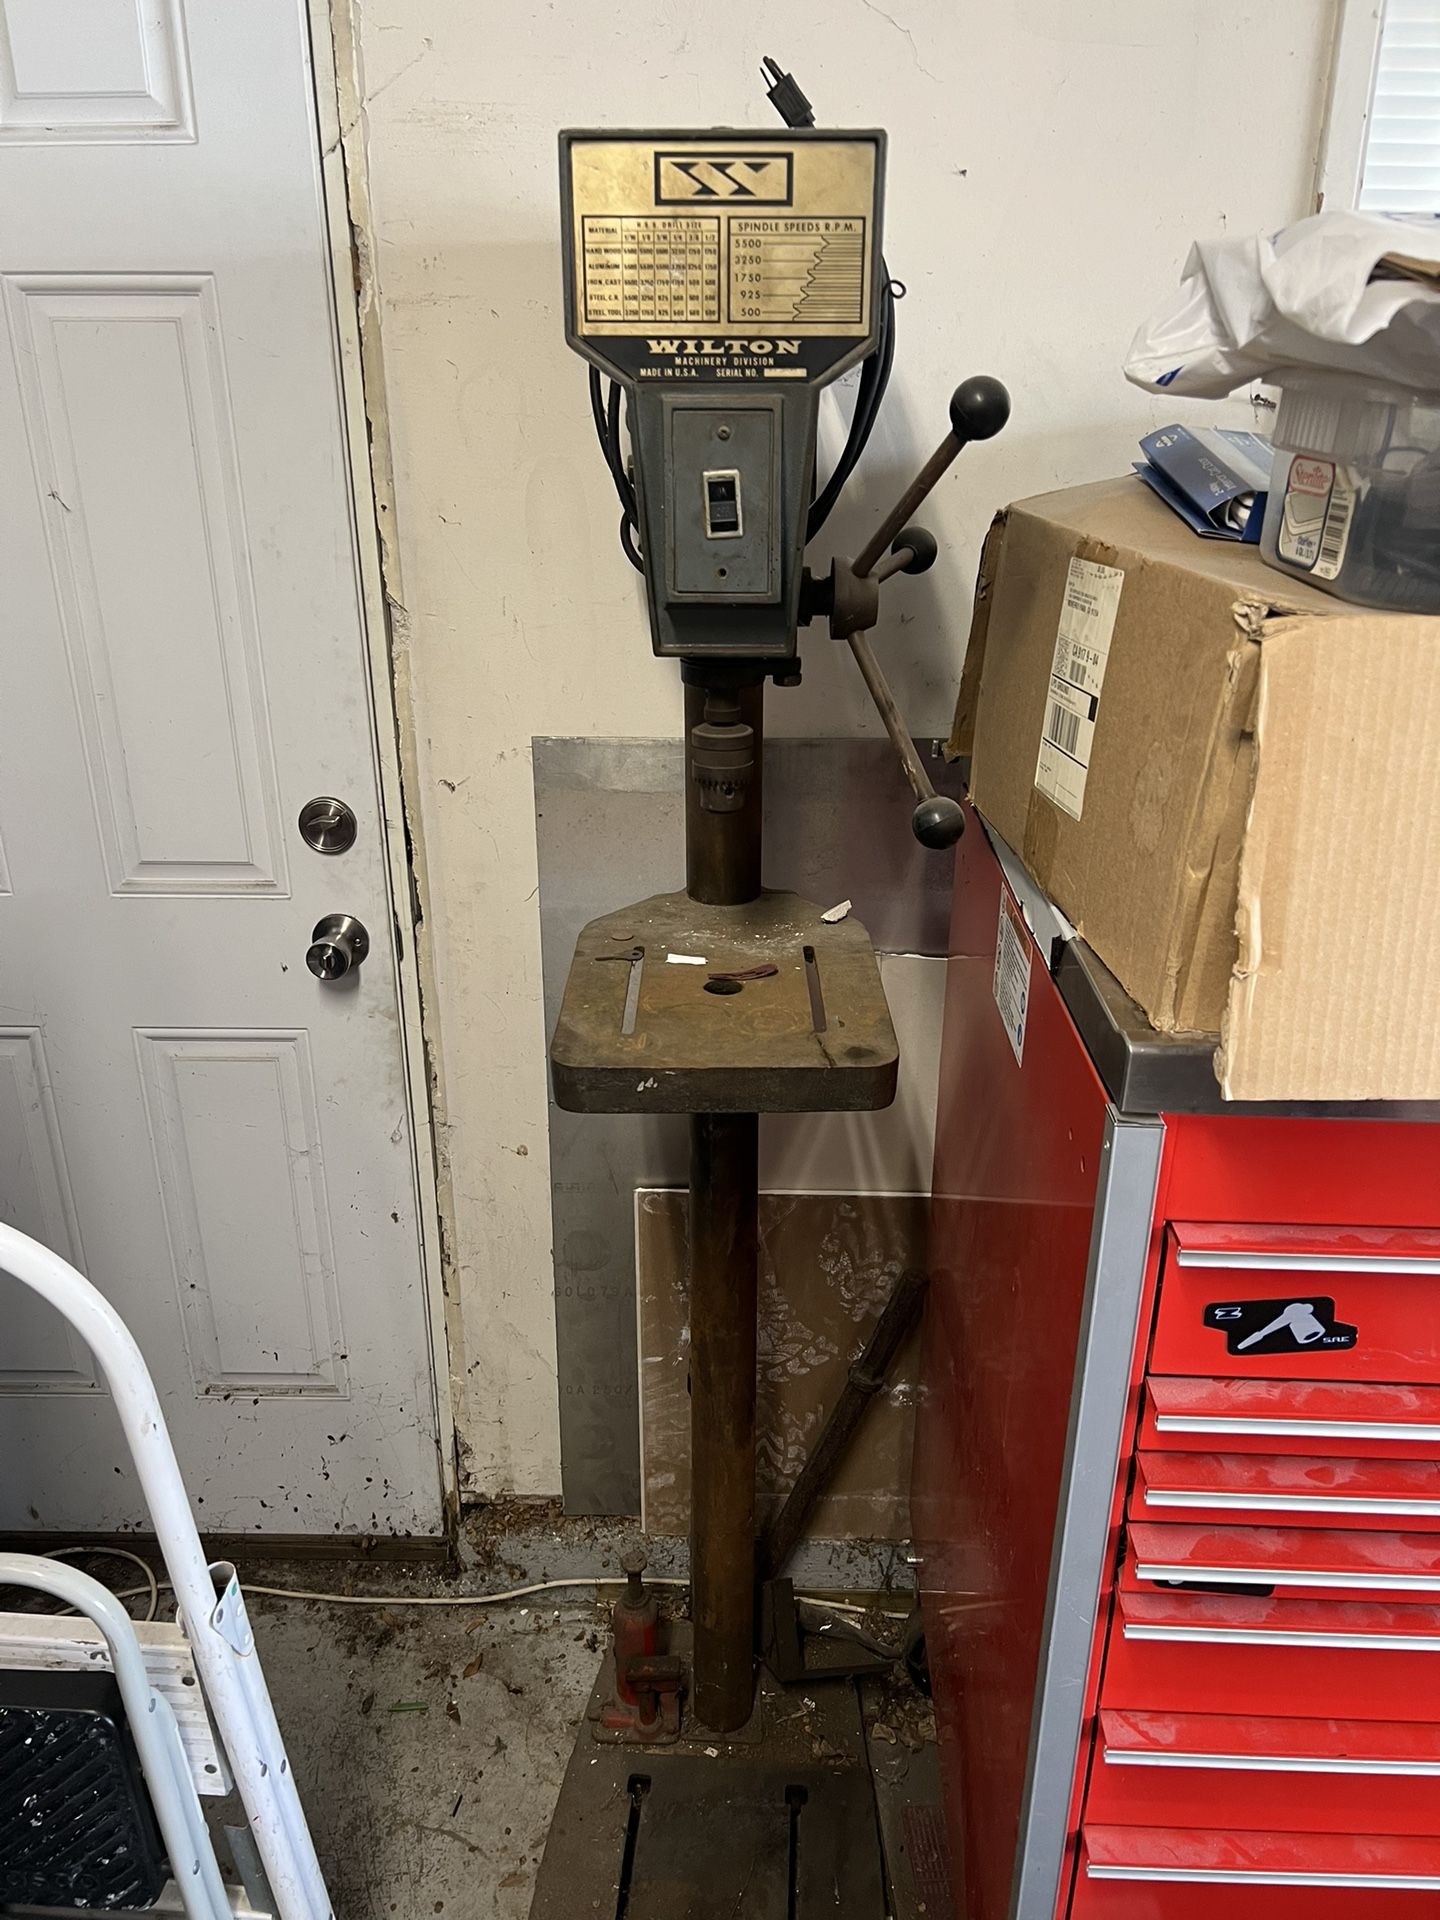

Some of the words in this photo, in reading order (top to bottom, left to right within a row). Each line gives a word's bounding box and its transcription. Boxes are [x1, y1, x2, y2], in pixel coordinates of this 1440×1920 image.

[738, 222, 779, 232] SPINDLE
[784, 222, 820, 232] SPEEDS
[735, 239, 762, 248] 5500
[735, 256, 762, 264] 3250
[735, 273, 761, 282] 1750
[740, 290, 760, 299] 925
[741, 308, 760, 317] 500
[646, 340, 802, 354] WILTON
[674, 357, 728, 366] MACHINERY
[734, 357, 774, 366] DIVISION
[640, 368, 662, 377] MADE
[664, 368, 672, 376] IN
[675, 368, 699, 377] U.S.A.
[716, 368, 743, 377] SERIAL
[746, 369, 759, 377] NO.
